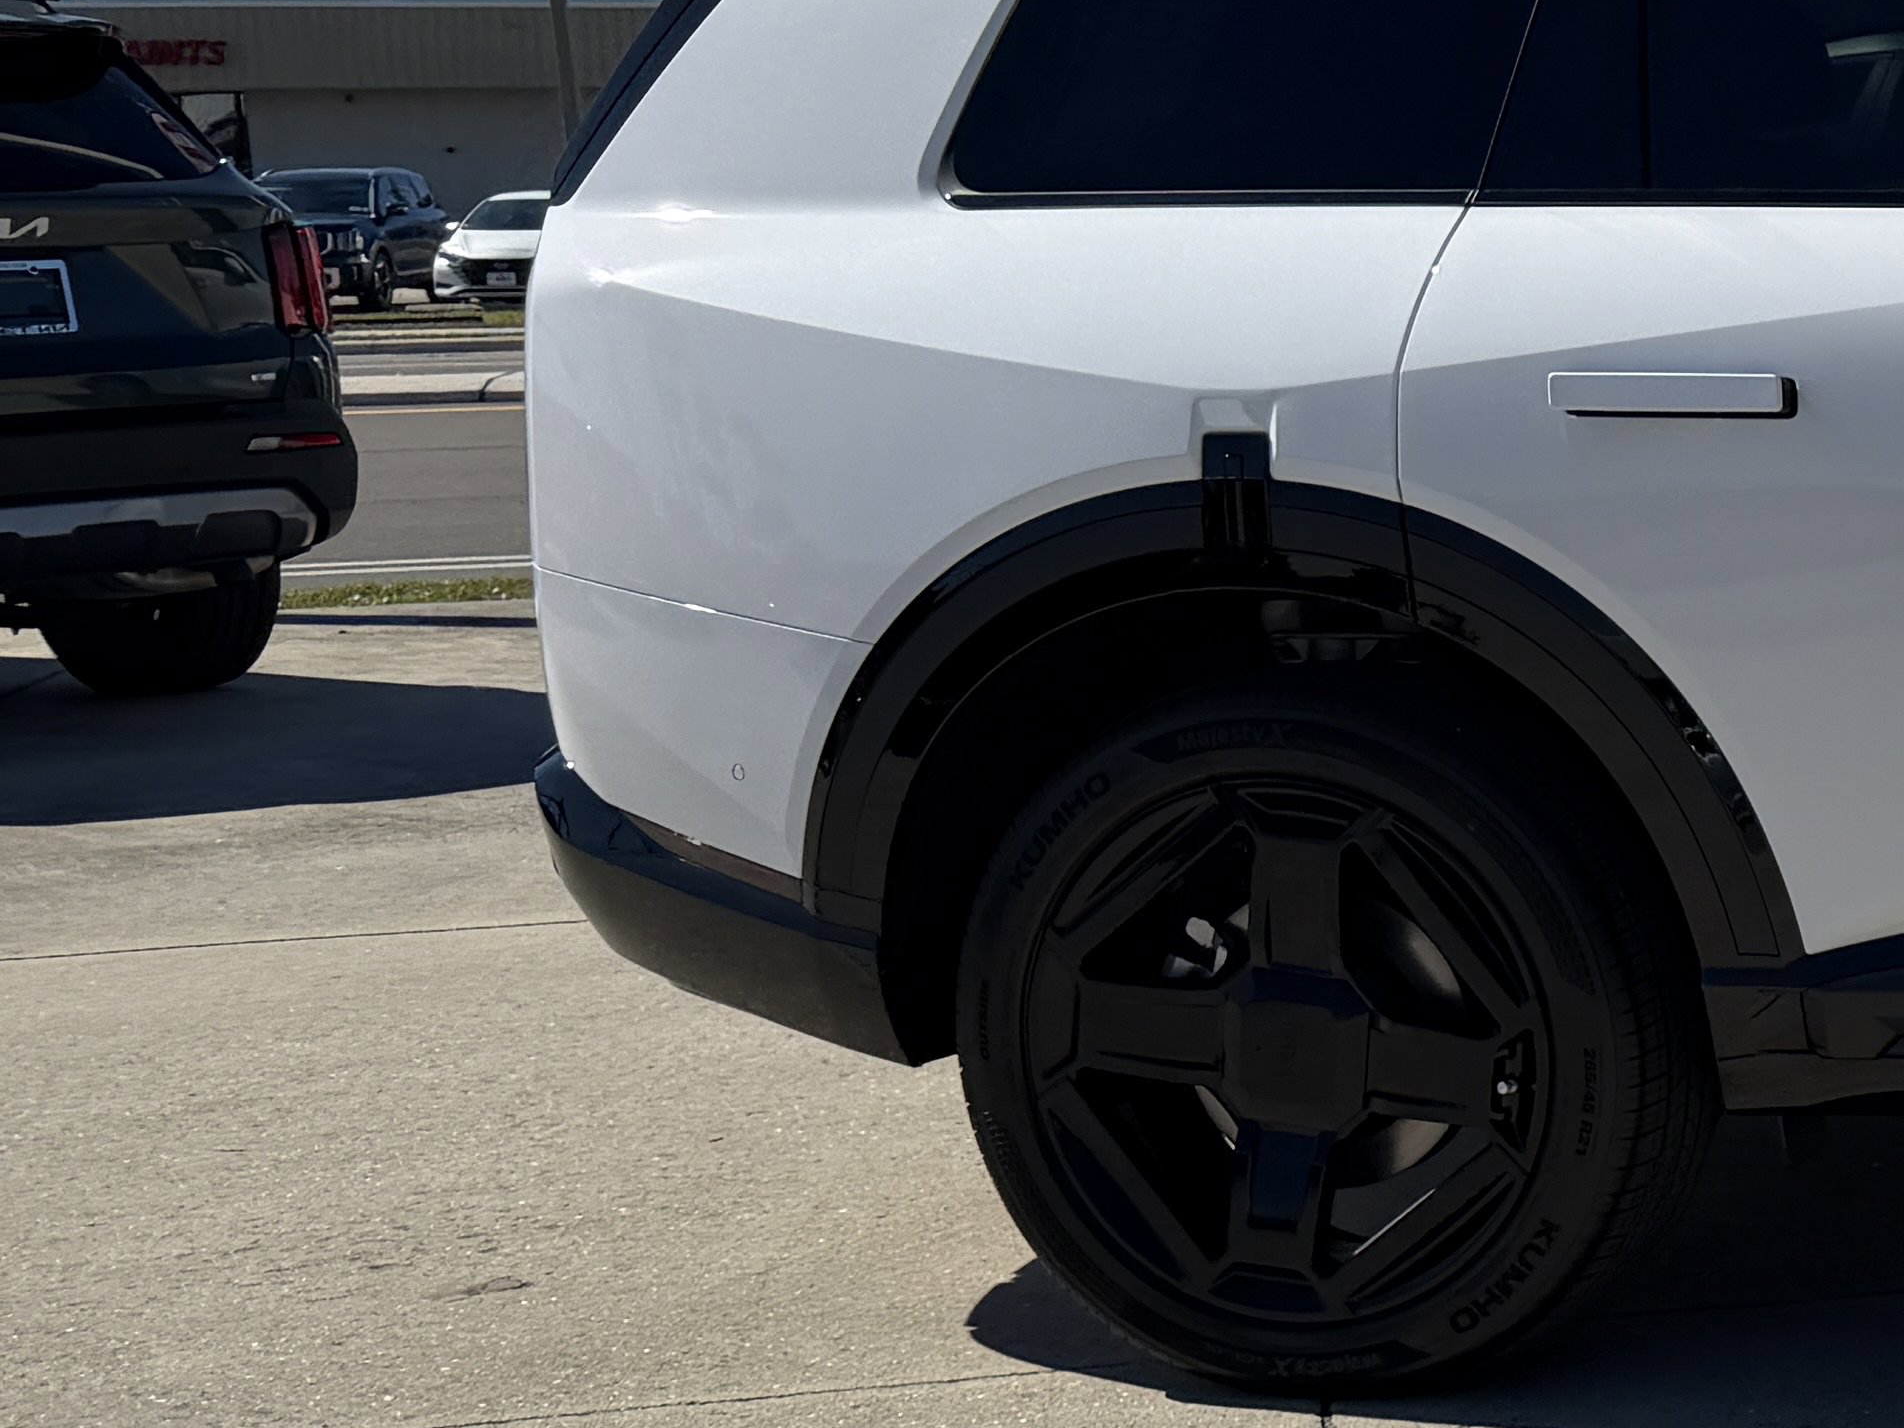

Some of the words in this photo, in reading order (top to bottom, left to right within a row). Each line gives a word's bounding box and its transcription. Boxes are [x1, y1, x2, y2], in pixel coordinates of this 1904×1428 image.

[1008, 770, 1112, 892] KUMHO
[1574, 1120, 1594, 1157] R21
[1449, 1218, 1562, 1334] KUMHO
